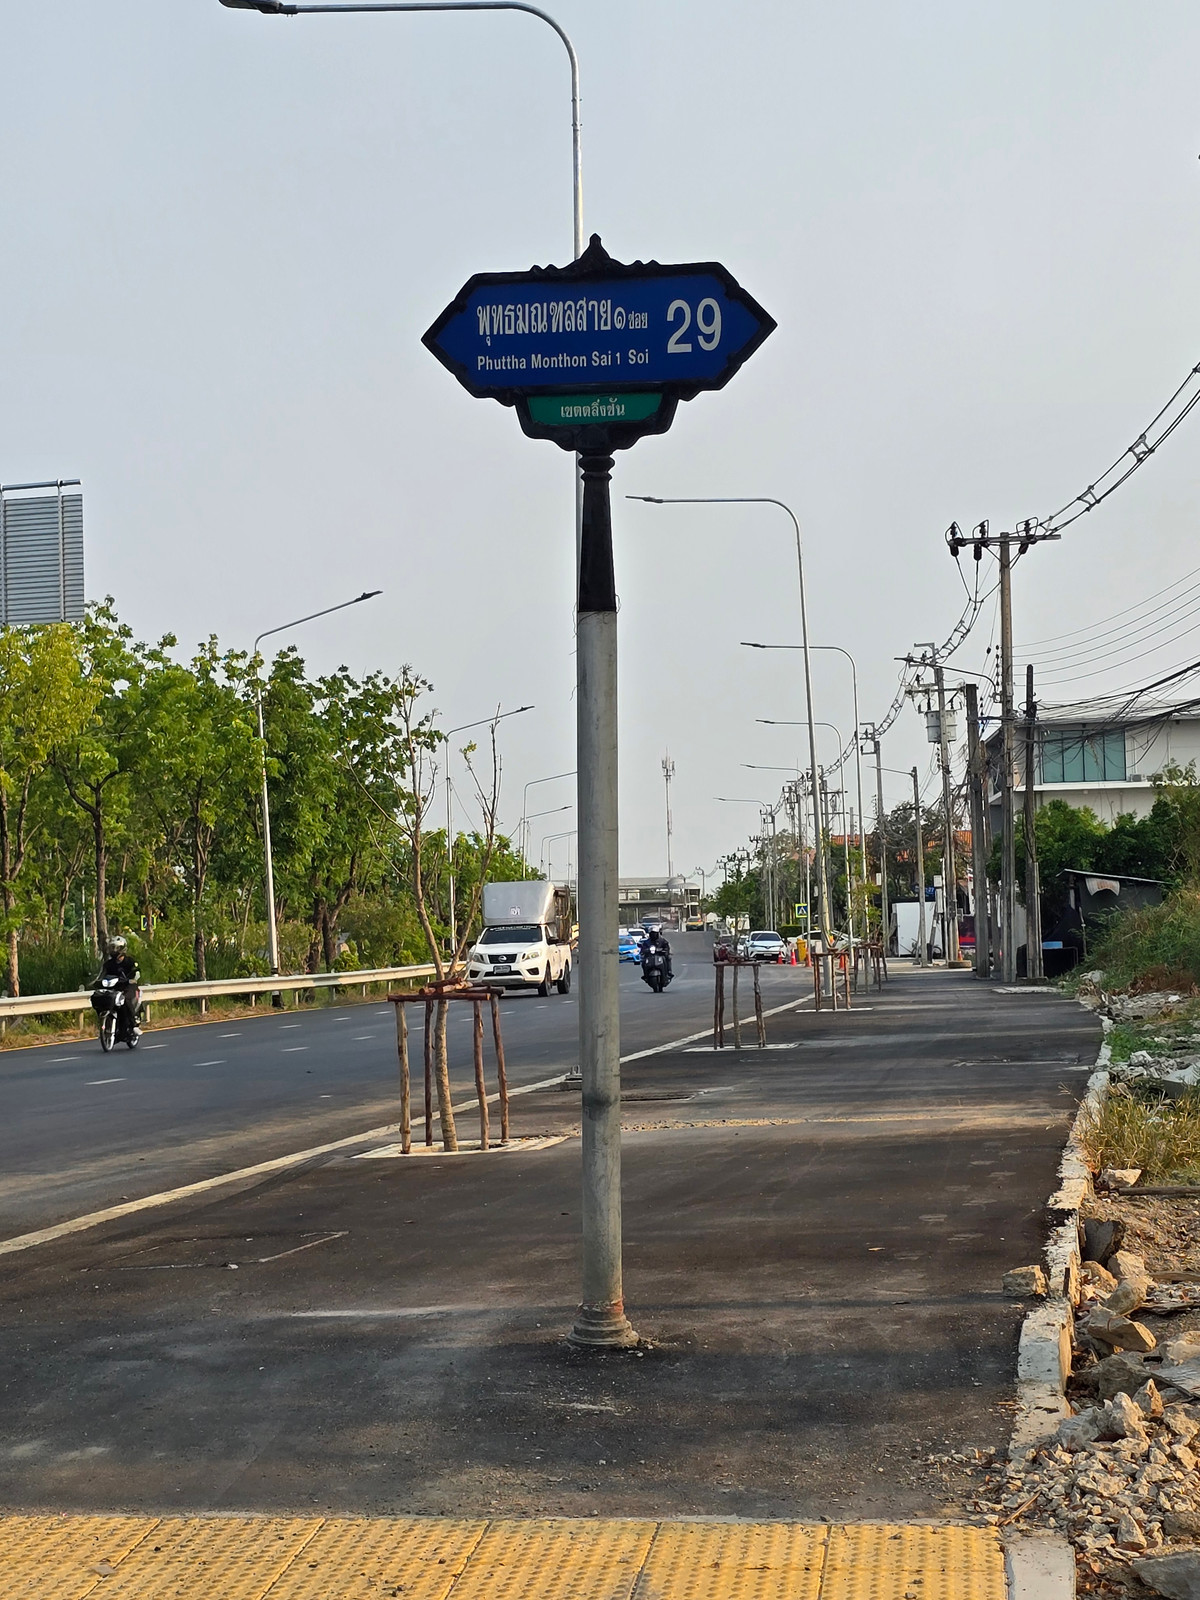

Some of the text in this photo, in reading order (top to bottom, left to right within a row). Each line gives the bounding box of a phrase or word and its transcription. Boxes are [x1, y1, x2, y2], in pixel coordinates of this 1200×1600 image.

[628, 310, 648, 330] ซอย
[666, 297, 722, 354] 29
[477, 348, 649, 371] Phuttha Monthon Sai 1 Soi
[560, 397, 625, 418] เขตตลิ่งชัน
